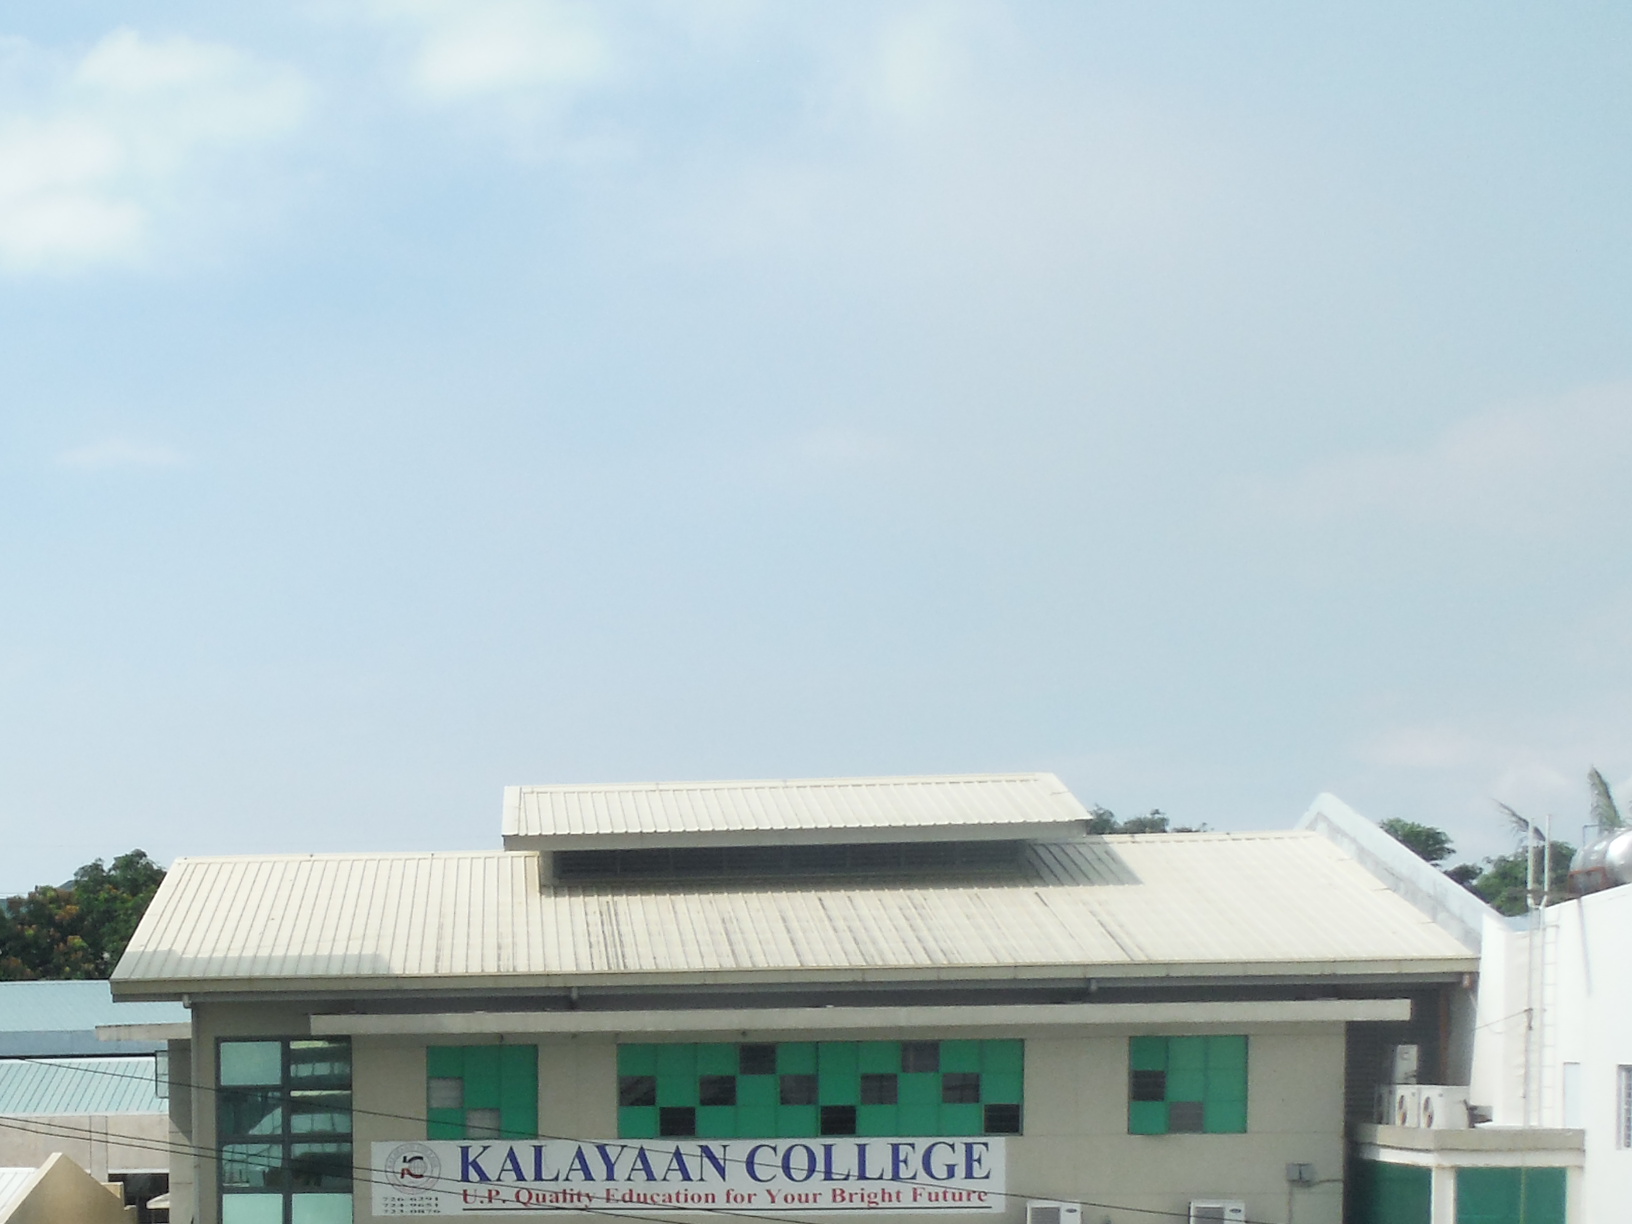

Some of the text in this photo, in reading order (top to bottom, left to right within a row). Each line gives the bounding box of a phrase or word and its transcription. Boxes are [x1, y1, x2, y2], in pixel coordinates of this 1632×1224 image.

[459, 1144, 730, 1183] KALAYAAN
[745, 1141, 992, 1183] COLLEGE
[462, 1187, 989, 1208] U.P. Quality Education for Your Bright Future
